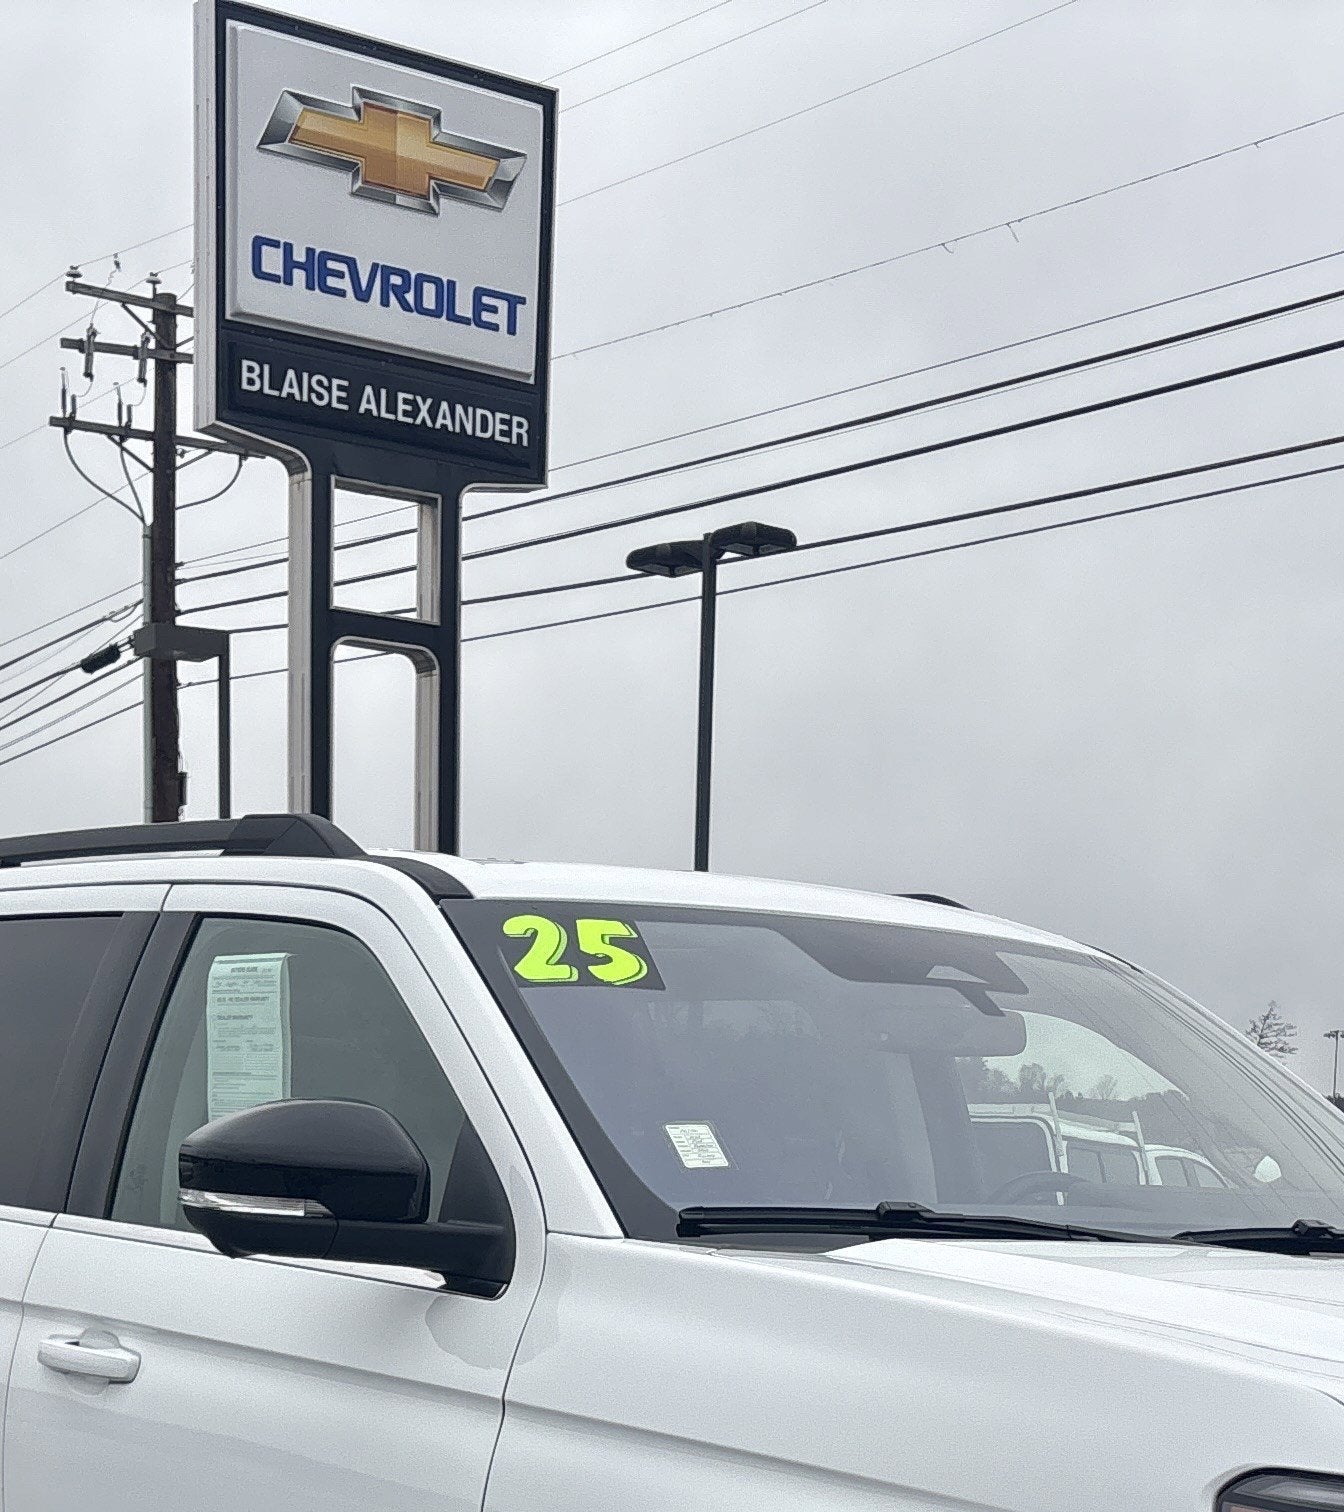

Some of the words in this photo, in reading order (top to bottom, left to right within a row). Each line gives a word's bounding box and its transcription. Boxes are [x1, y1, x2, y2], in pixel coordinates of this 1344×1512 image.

[251, 233, 527, 337] CHEVROLET
[240, 358, 350, 411] BLAISE
[358, 384, 530, 448] ALEXANDER
[502, 913, 650, 986] 25
